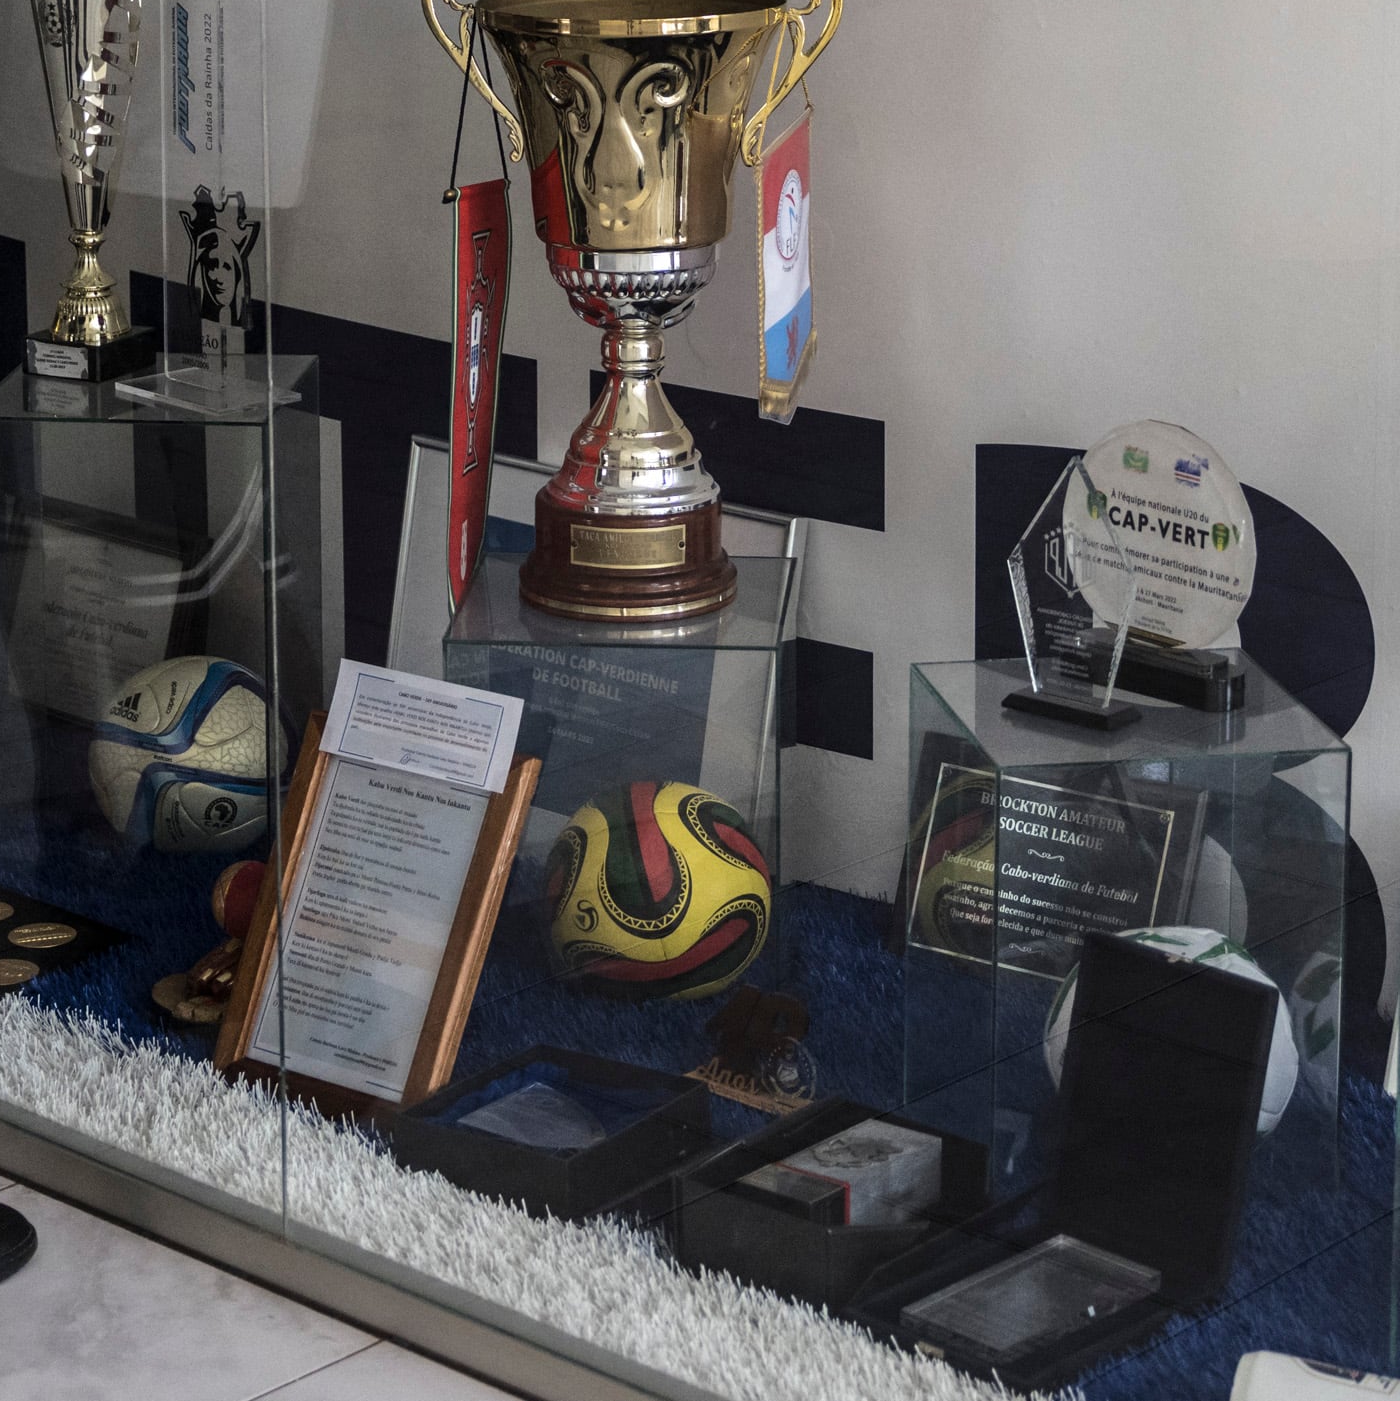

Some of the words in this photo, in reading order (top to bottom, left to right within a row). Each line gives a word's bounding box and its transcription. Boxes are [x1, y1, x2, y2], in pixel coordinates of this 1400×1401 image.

[204, 14, 212, 44] 2022
[204, 47, 212, 89] Rainha
[204, 92, 212, 108] da
[204, 111, 212, 151] Caldas
[1108, 507, 1209, 550] CAP-VERT
[1148, 499, 1182, 517] nationale
[1183, 508, 1198, 521] U20
[1199, 513, 1209, 524] du
[532, 667, 550, 683] DE
[552, 672, 622, 701] FOOTBALL
[1000, 816, 1049, 840] SOCCER
[1051, 827, 1104, 851] LEAGUE
[1059, 808, 1126, 835] AMATEUR
[1001, 862, 1078, 892] Cabo-verdiana
[1080, 880, 1095, 895] de
[1097, 884, 1139, 904] Futebol
